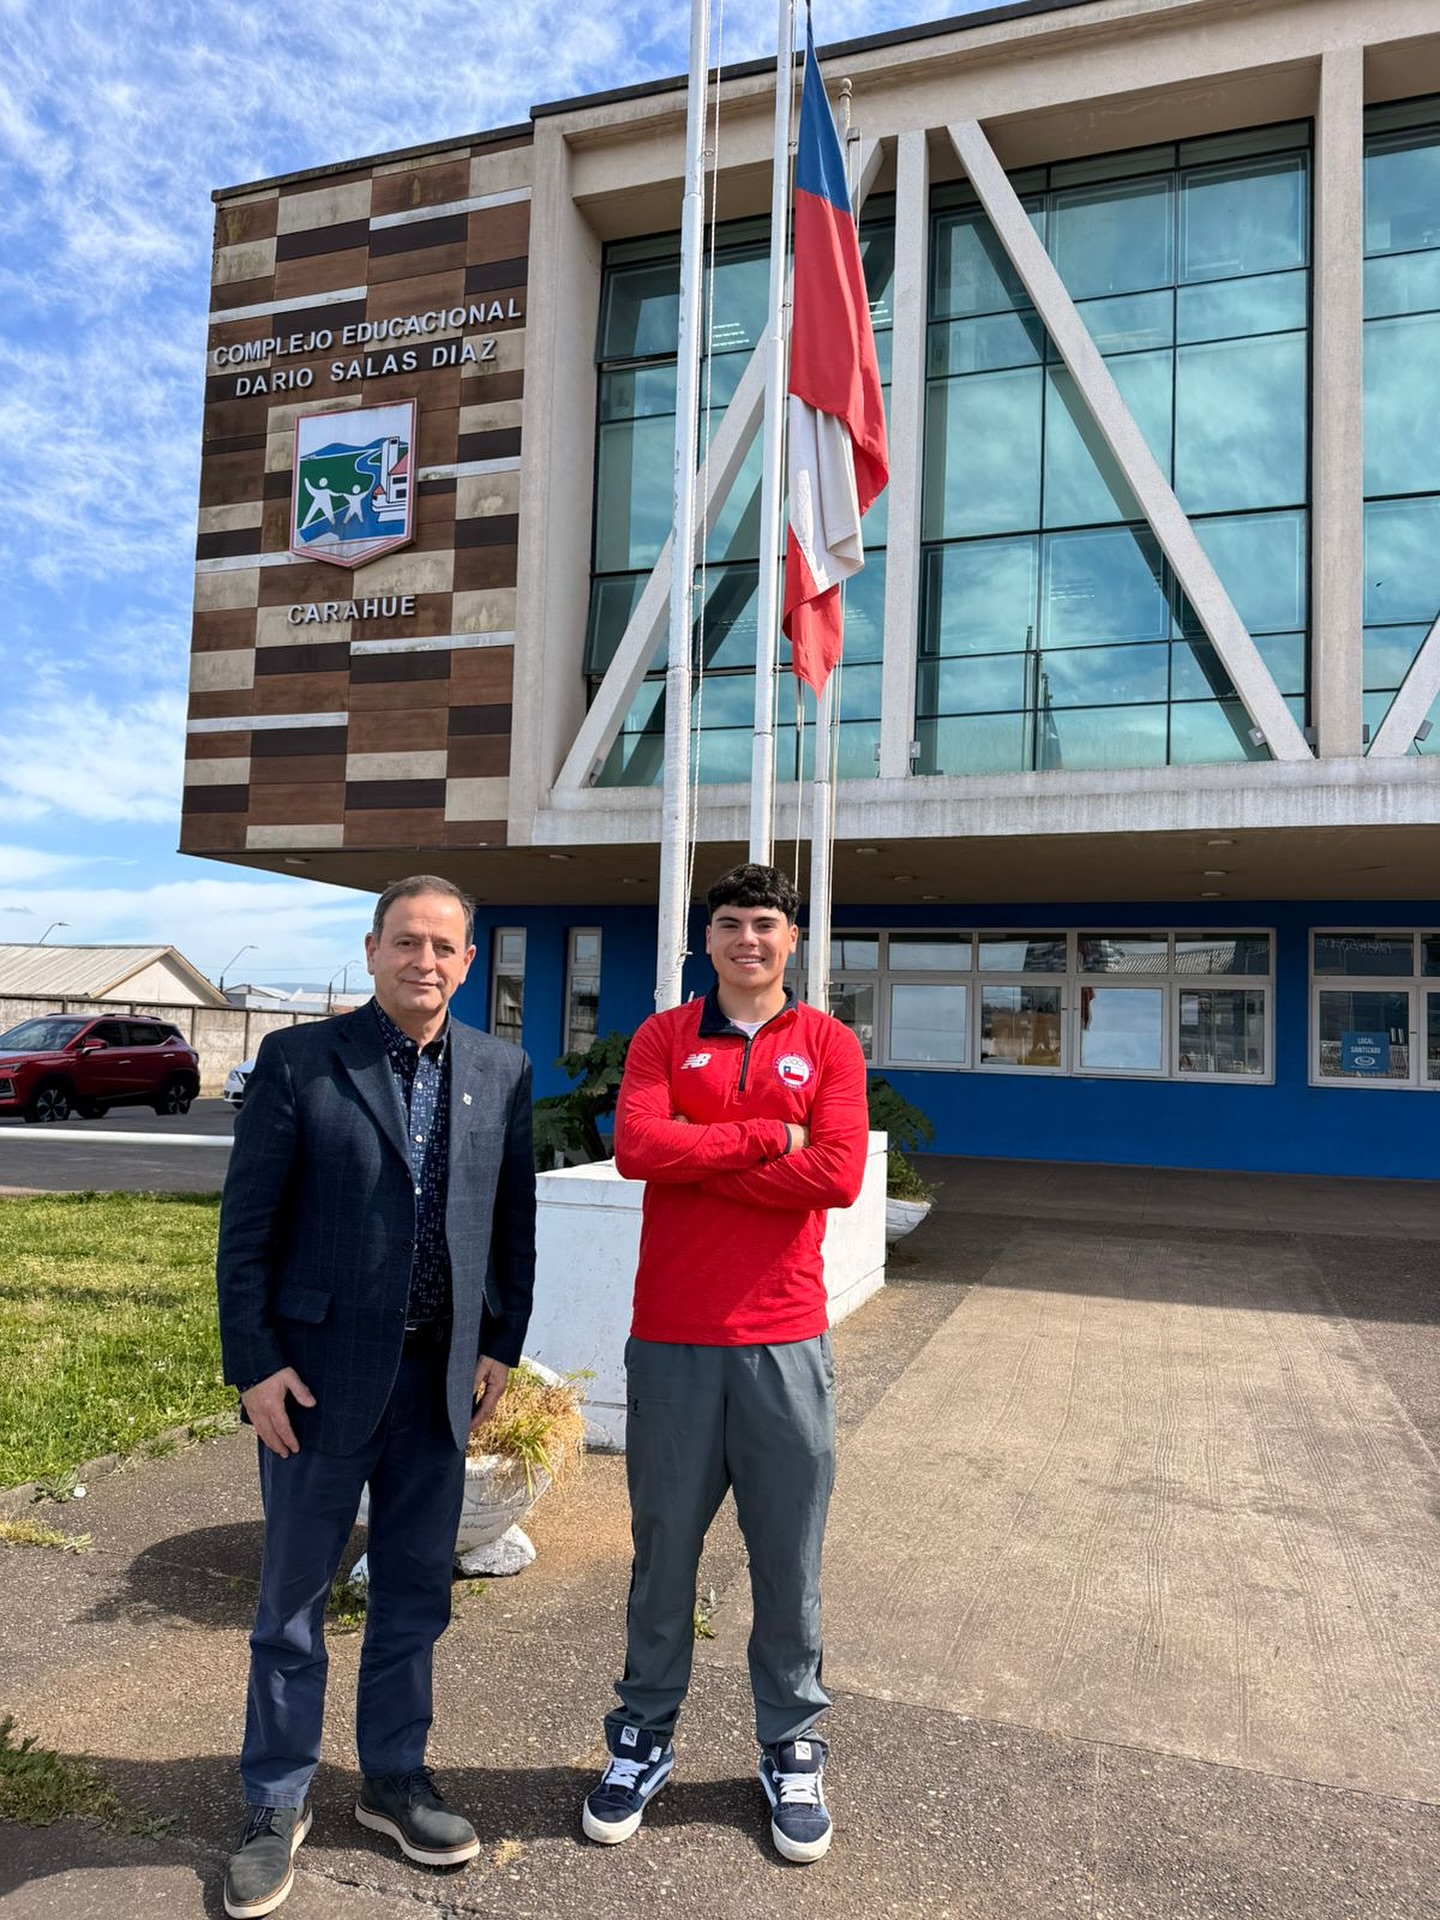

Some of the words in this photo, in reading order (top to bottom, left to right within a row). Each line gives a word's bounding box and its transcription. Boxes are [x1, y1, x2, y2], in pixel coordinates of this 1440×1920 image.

[213, 329, 333, 366] COMPLEJO
[342, 298, 522, 346] EDUCACIONAL
[235, 368, 314, 397] DARIO
[330, 351, 418, 382] SALAS
[432, 339, 497, 368] DIAZ
[287, 595, 416, 625] CARAHUE
